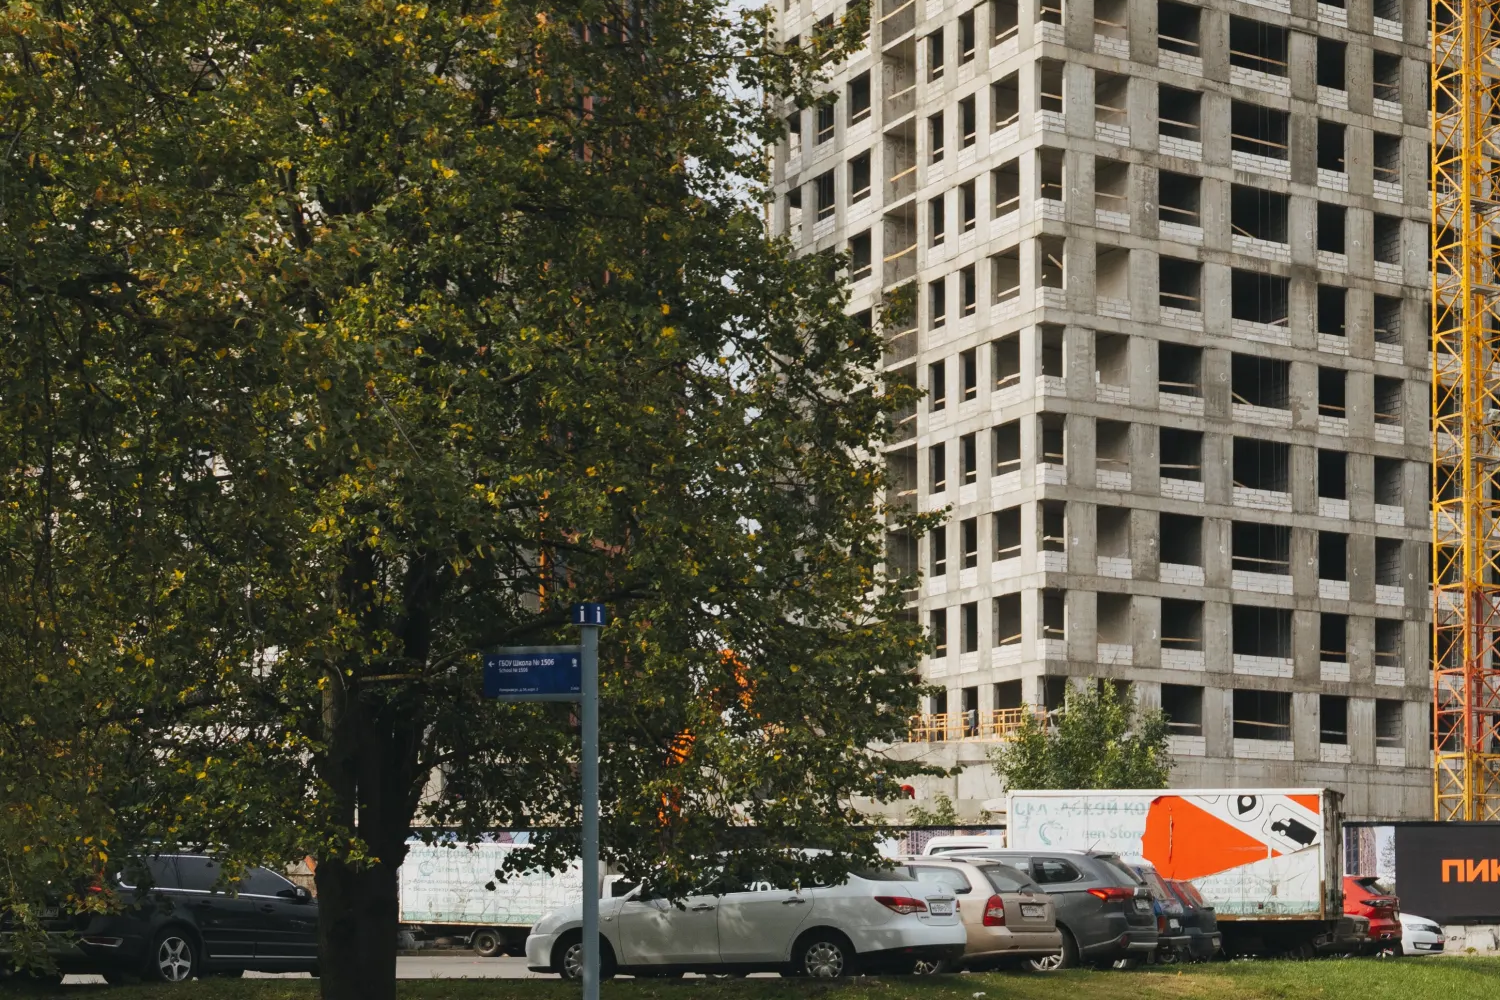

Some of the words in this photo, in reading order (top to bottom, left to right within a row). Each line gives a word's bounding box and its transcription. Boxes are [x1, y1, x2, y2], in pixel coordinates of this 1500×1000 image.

[498, 660, 513, 668] ГБОУ
[513, 659, 533, 667] Школа
[541, 658, 555, 666] 1506
